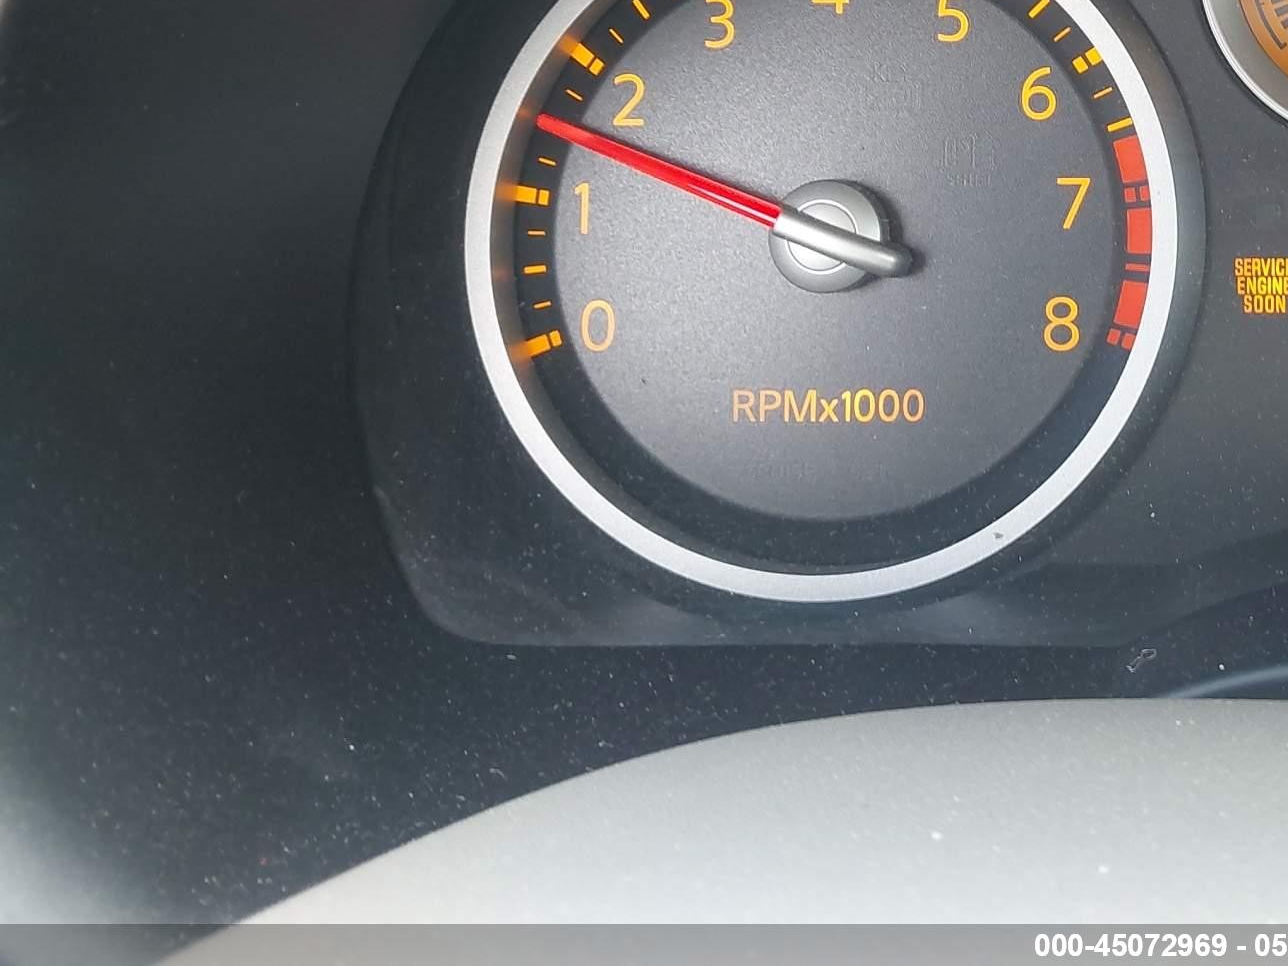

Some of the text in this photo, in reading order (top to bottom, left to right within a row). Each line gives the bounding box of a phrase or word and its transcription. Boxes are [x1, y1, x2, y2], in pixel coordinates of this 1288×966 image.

[614, 73, 644, 127] 2
[1021, 67, 1056, 121] 6
[575, 183, 590, 234] 1
[1057, 177, 1091, 229] 7
[582, 301, 613, 352] 0
[1044, 297, 1080, 351] 8
[1243, 296, 1288, 314] SOON
[731, 389, 925, 423] RPMx1000
